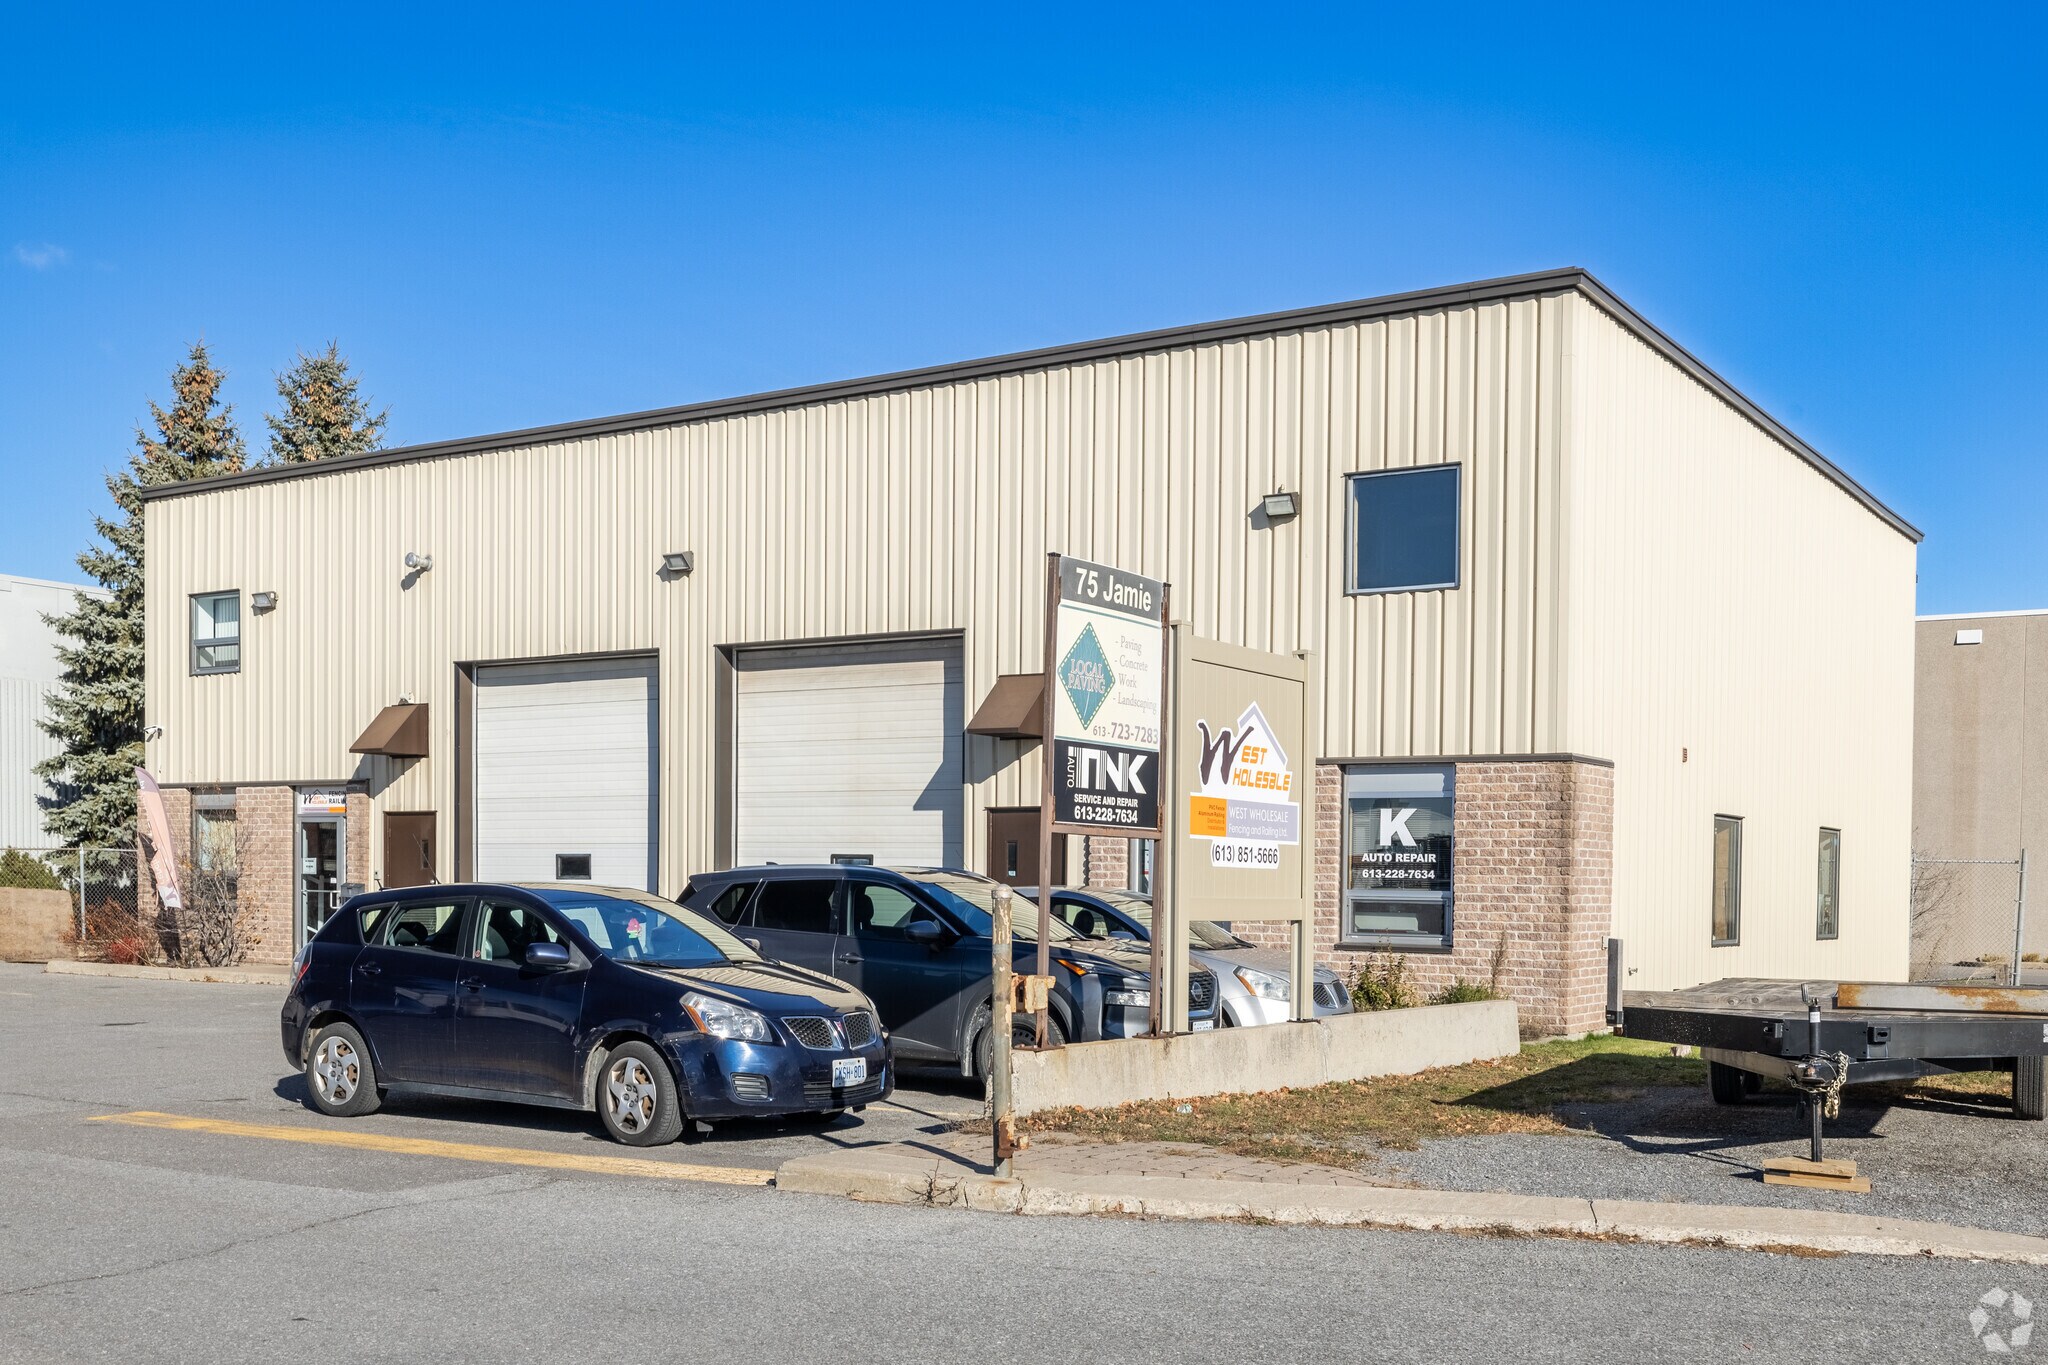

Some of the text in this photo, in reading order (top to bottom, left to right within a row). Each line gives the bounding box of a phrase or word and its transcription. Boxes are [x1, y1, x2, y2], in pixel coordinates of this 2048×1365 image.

[1076, 567, 1152, 612] 75 Jamie
[1120, 635, 1142, 656] Paving
[1070, 658, 1104, 680] LOCAL
[1119, 654, 1149, 672] Concrete
[1067, 672, 1106, 694] PAVING
[1118, 673, 1138, 689] Work
[1117, 691, 1157, 715] Landscaping
[1066, 756, 1076, 789] AUTO
[1073, 793, 1138, 808] SERVICE AND REPAIR
[1074, 805, 1138, 824] 613-228-7634
[1228, 806, 1289, 823] WEST WHOLESALE
[1228, 823, 1250, 837] Fencing
[1250, 826, 1261, 835] and
[1261, 827, 1279, 839] Railing
[1379, 808, 1418, 847] K
[1211, 843, 1279, 865] (613) 851-5666
[1361, 853, 1437, 863] AUTO REPAIR
[1362, 869, 1435, 880] 613-228-7634
